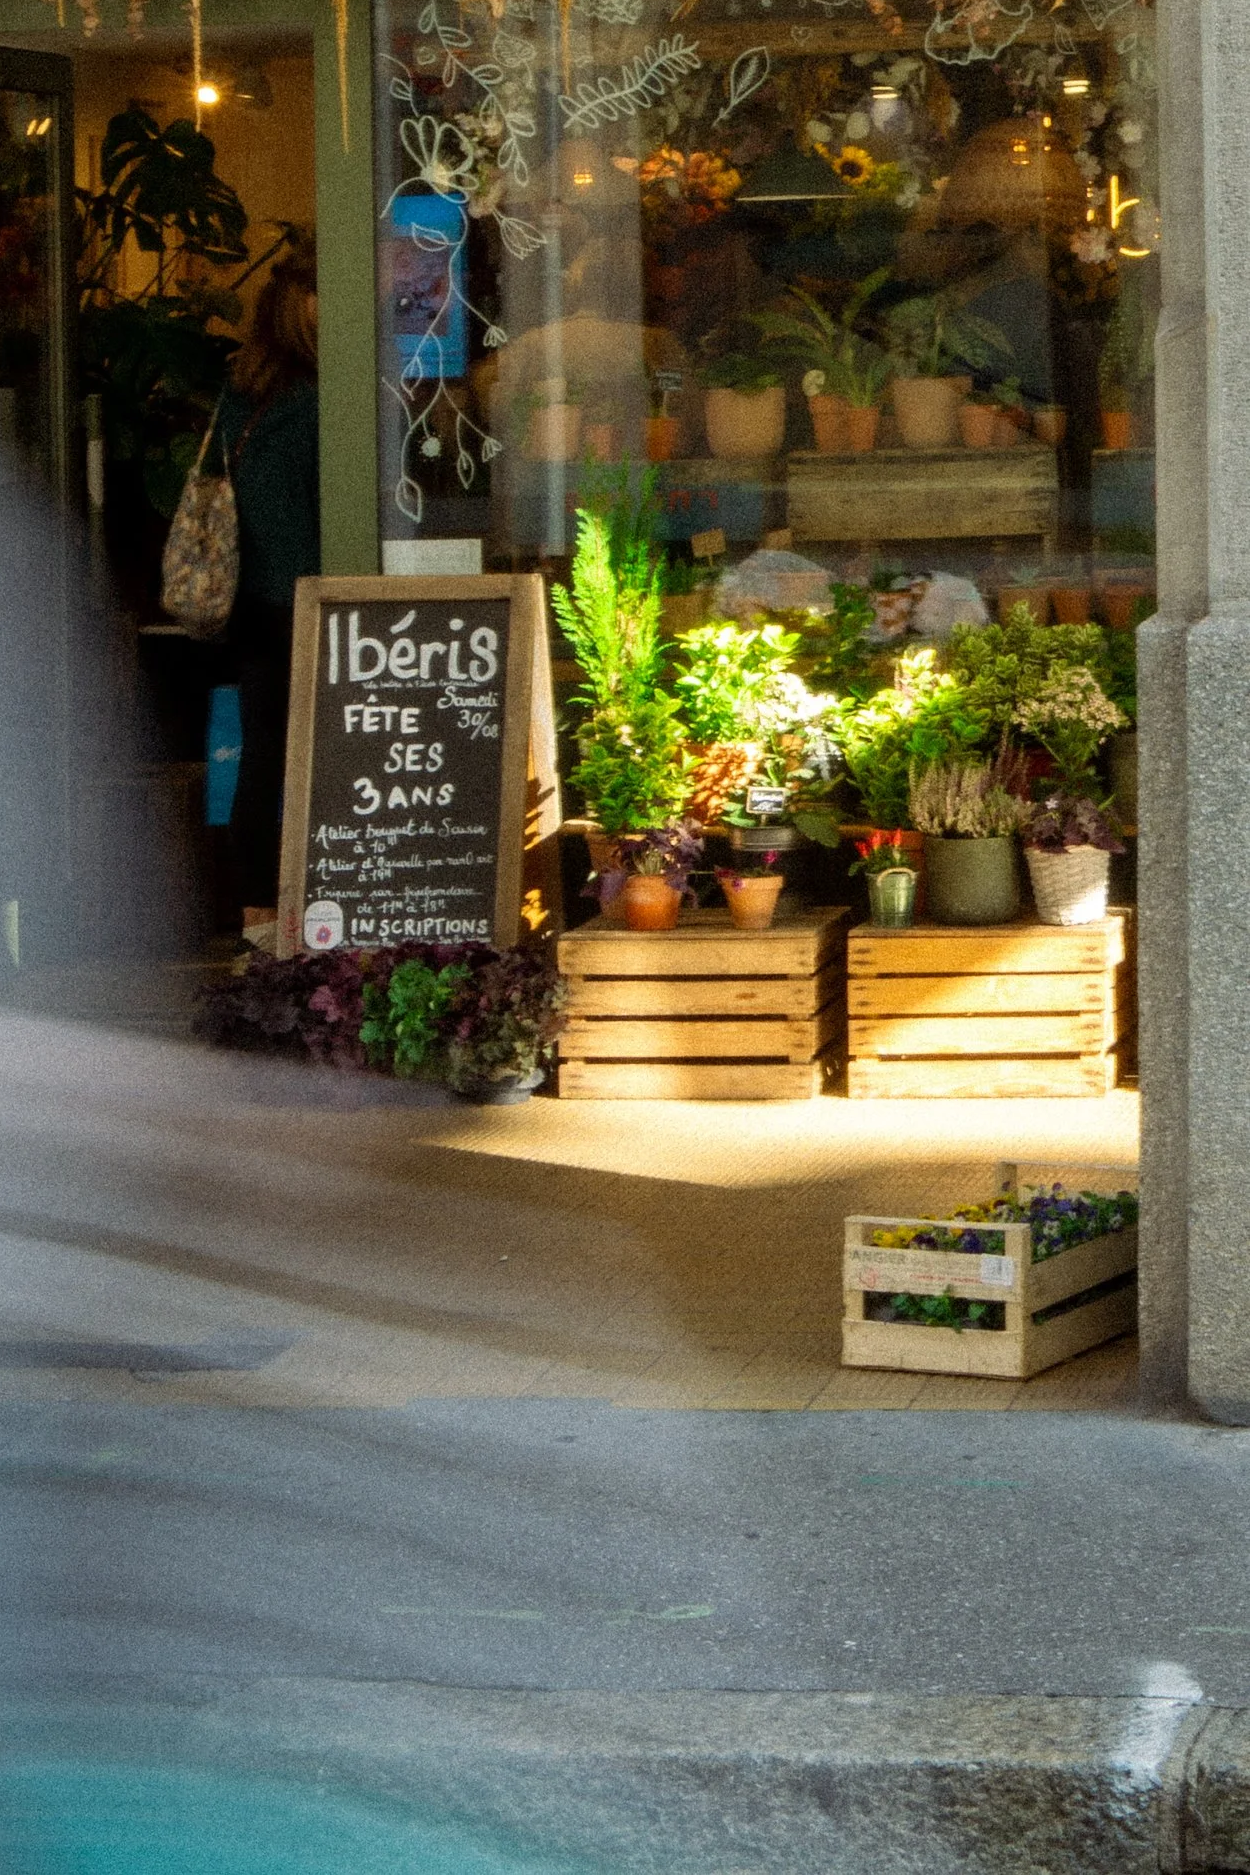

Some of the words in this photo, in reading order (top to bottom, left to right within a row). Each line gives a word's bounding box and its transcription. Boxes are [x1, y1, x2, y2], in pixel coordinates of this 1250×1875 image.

[328, 609, 498, 684] Ibéris
[437, 685, 499, 709] Samedi
[344, 693, 421, 734] FÊTE
[384, 742, 444, 773] SES
[353, 777, 381, 815] 3
[387, 783, 455, 809] ANS
[315, 823, 361, 850] Atelier
[317, 858, 357, 881] Atelier
[351, 918, 488, 937] INSCRIPTIONS
